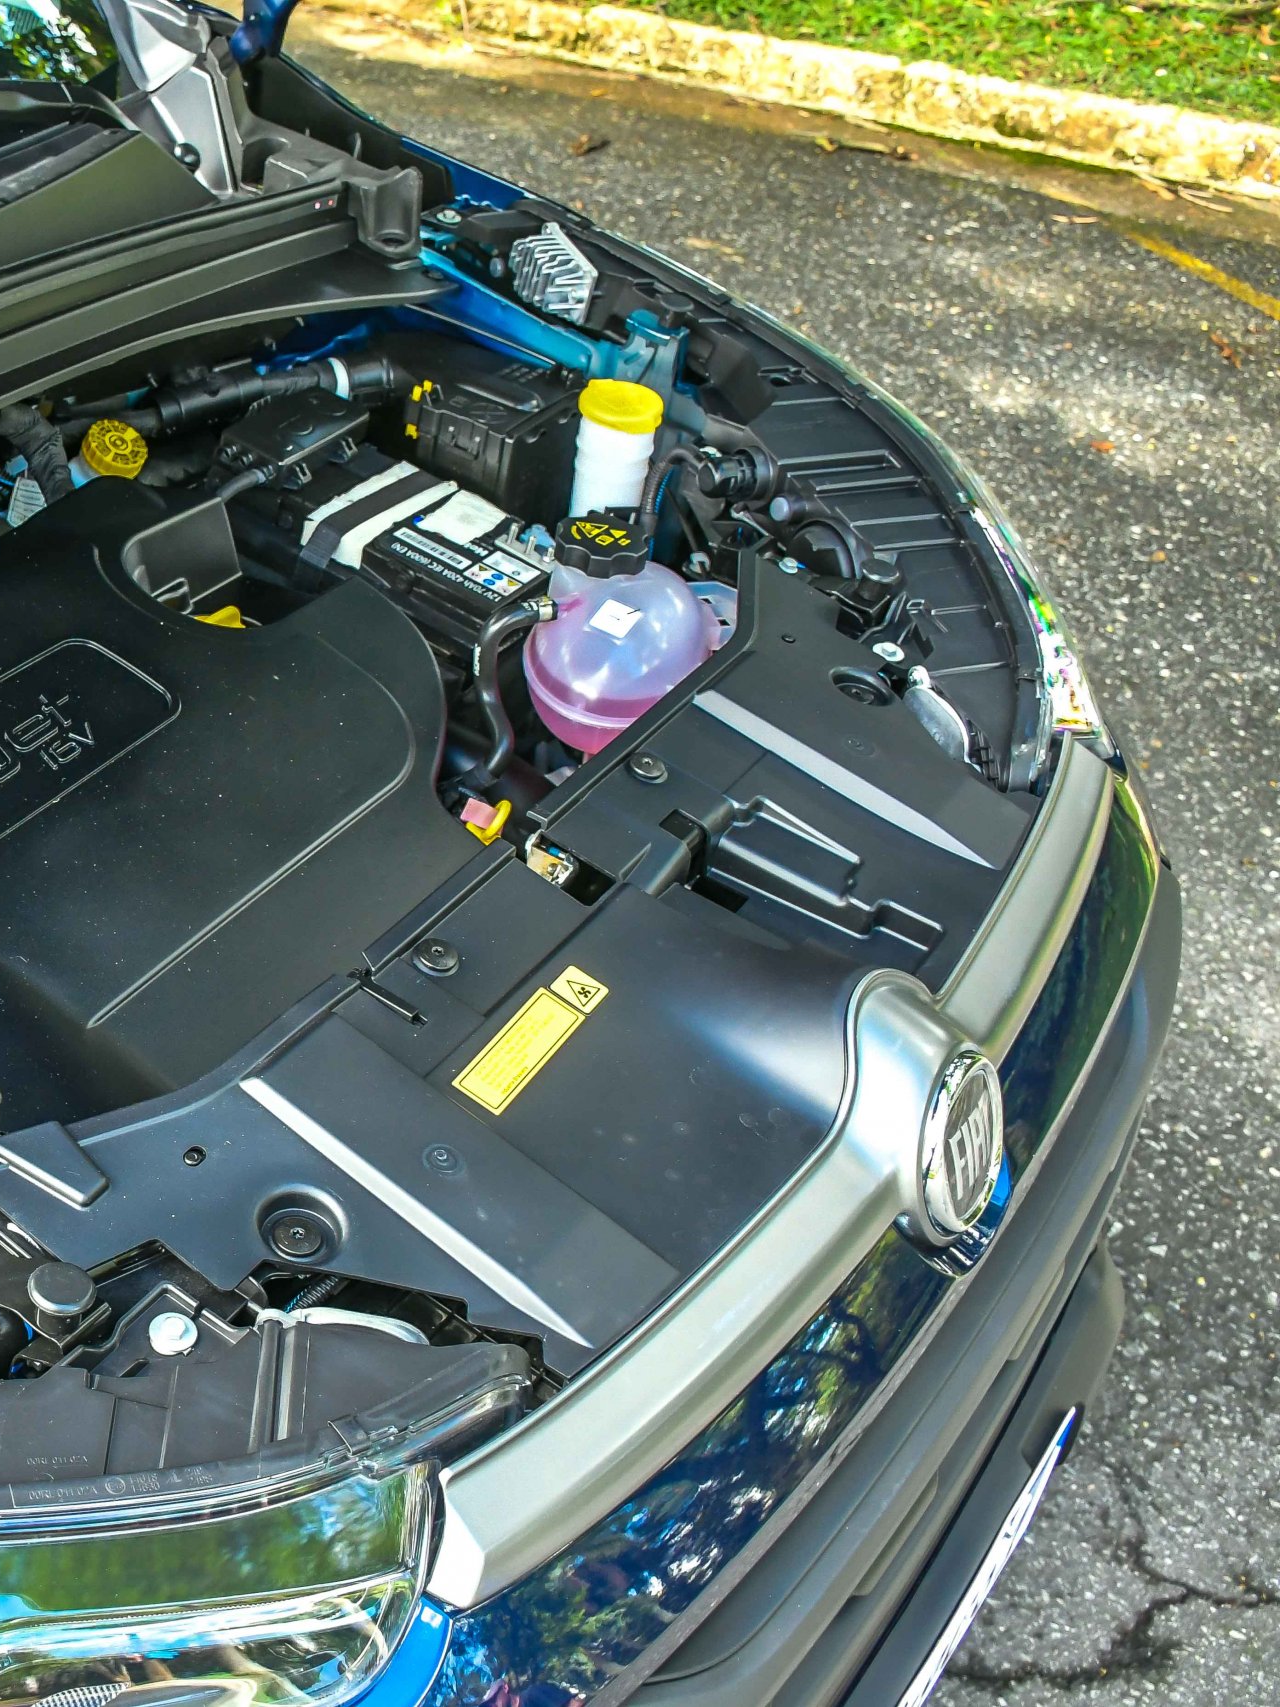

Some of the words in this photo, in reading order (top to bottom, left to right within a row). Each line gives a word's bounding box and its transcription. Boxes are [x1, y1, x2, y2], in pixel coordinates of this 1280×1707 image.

[443, 569, 464, 583] 420A
[464, 579, 485, 594] 70Ah
[485, 590, 501, 602] 12V
[39, 722, 94, 770] 16V
[947, 1090, 993, 1200] FIAT
